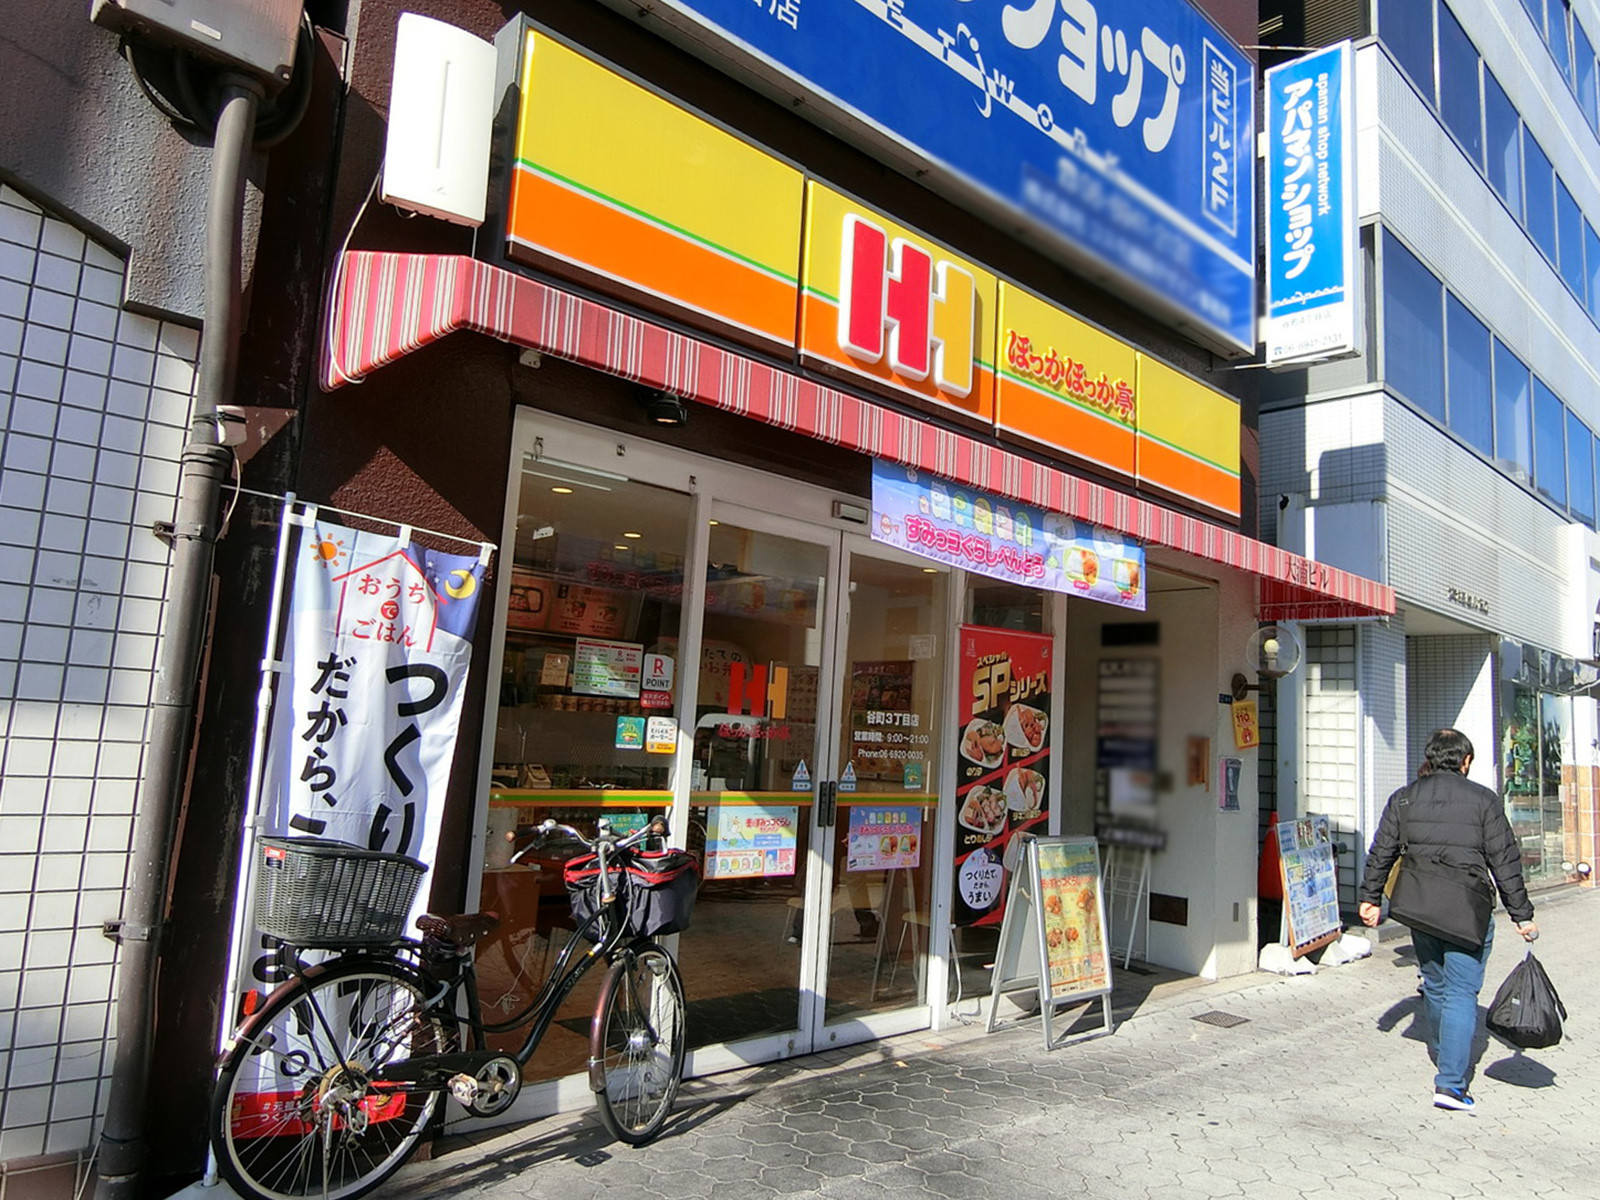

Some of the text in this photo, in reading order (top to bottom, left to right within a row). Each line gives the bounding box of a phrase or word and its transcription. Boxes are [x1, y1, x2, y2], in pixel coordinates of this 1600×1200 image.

[1315, 72, 1331, 216] apaman shop network
[1281, 77, 1316, 280] アパマンショップ
[1007, 330, 1134, 416] ほっかほっか亭
[357, 574, 426, 605] おうち
[382, 601, 400, 618] で
[352, 618, 417, 648] ごはん
[646, 678, 670, 688] POINT
[972, 662, 1011, 715] SP
[1010, 670, 1047, 702] シリーズ
[866, 711, 920, 727] 谷町3丁目店
